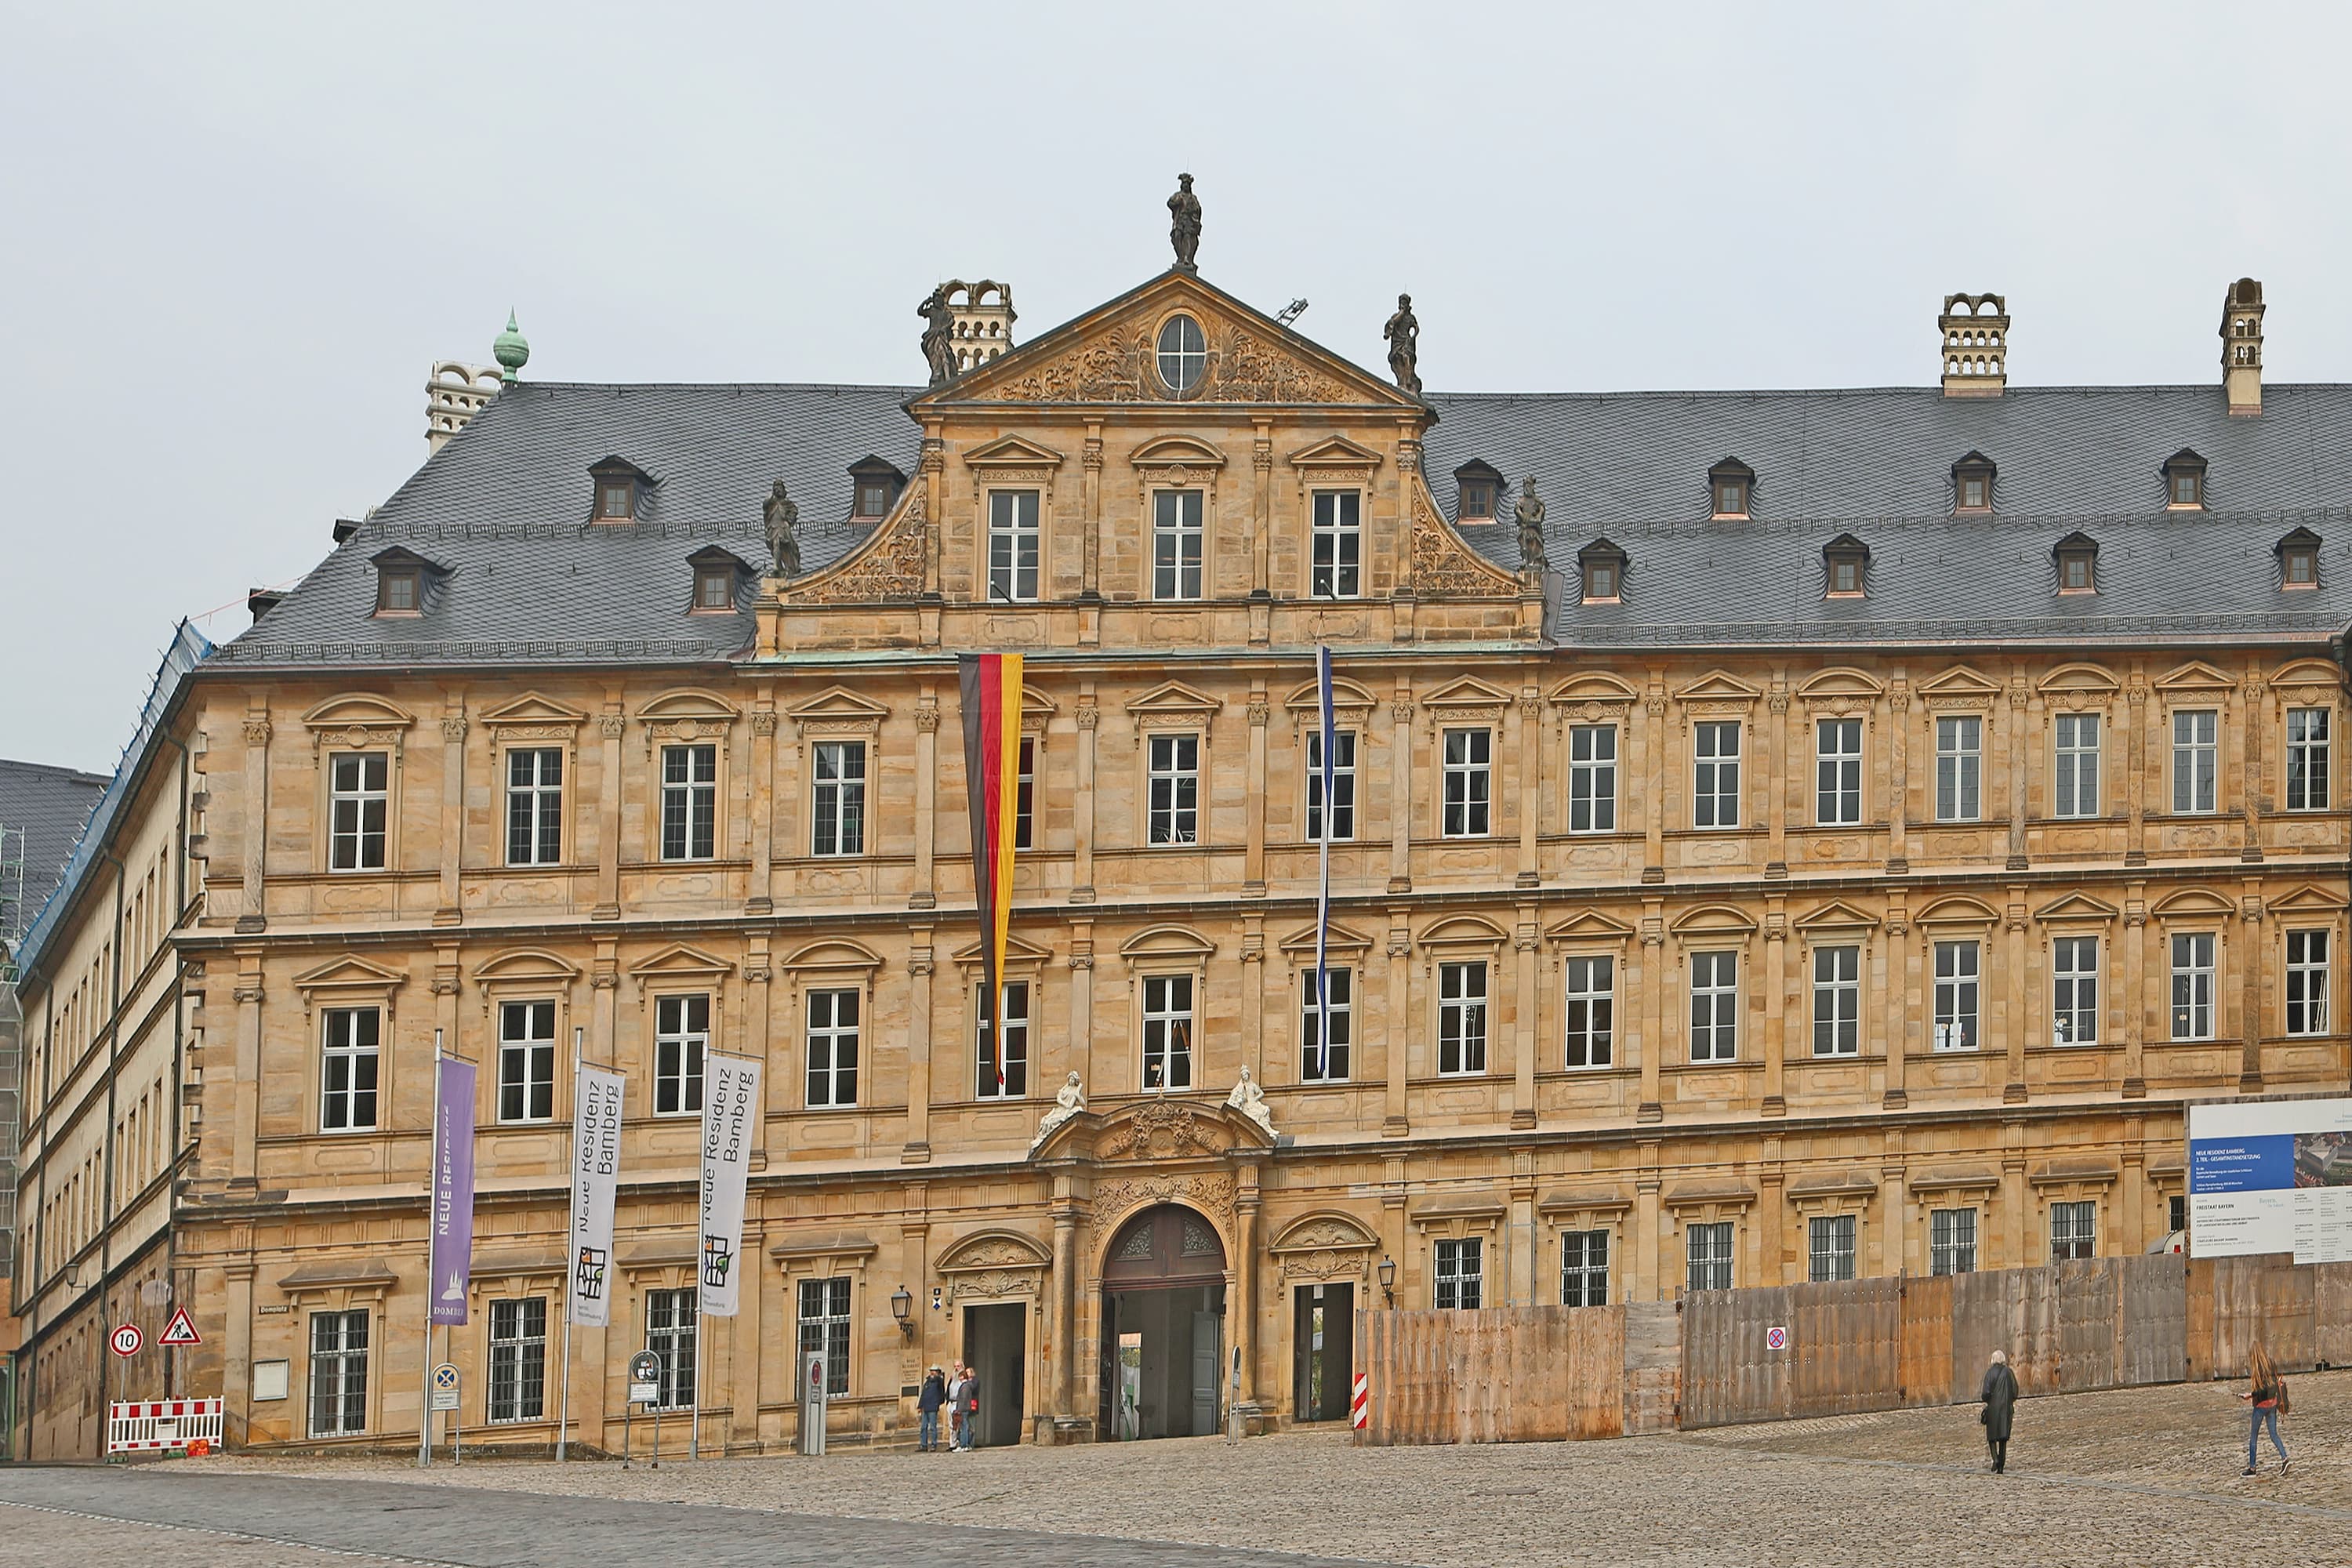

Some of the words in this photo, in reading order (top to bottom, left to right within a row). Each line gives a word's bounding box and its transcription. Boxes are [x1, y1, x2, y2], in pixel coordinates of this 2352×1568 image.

[582, 1081, 601, 1172] Residenz
[597, 1084, 619, 1174] Bamberg
[706, 1069, 731, 1160] Residenz
[723, 1071, 753, 1163] Bamberg
[439, 1190, 452, 1235] NEUE
[120, 1334, 135, 1348] 10
